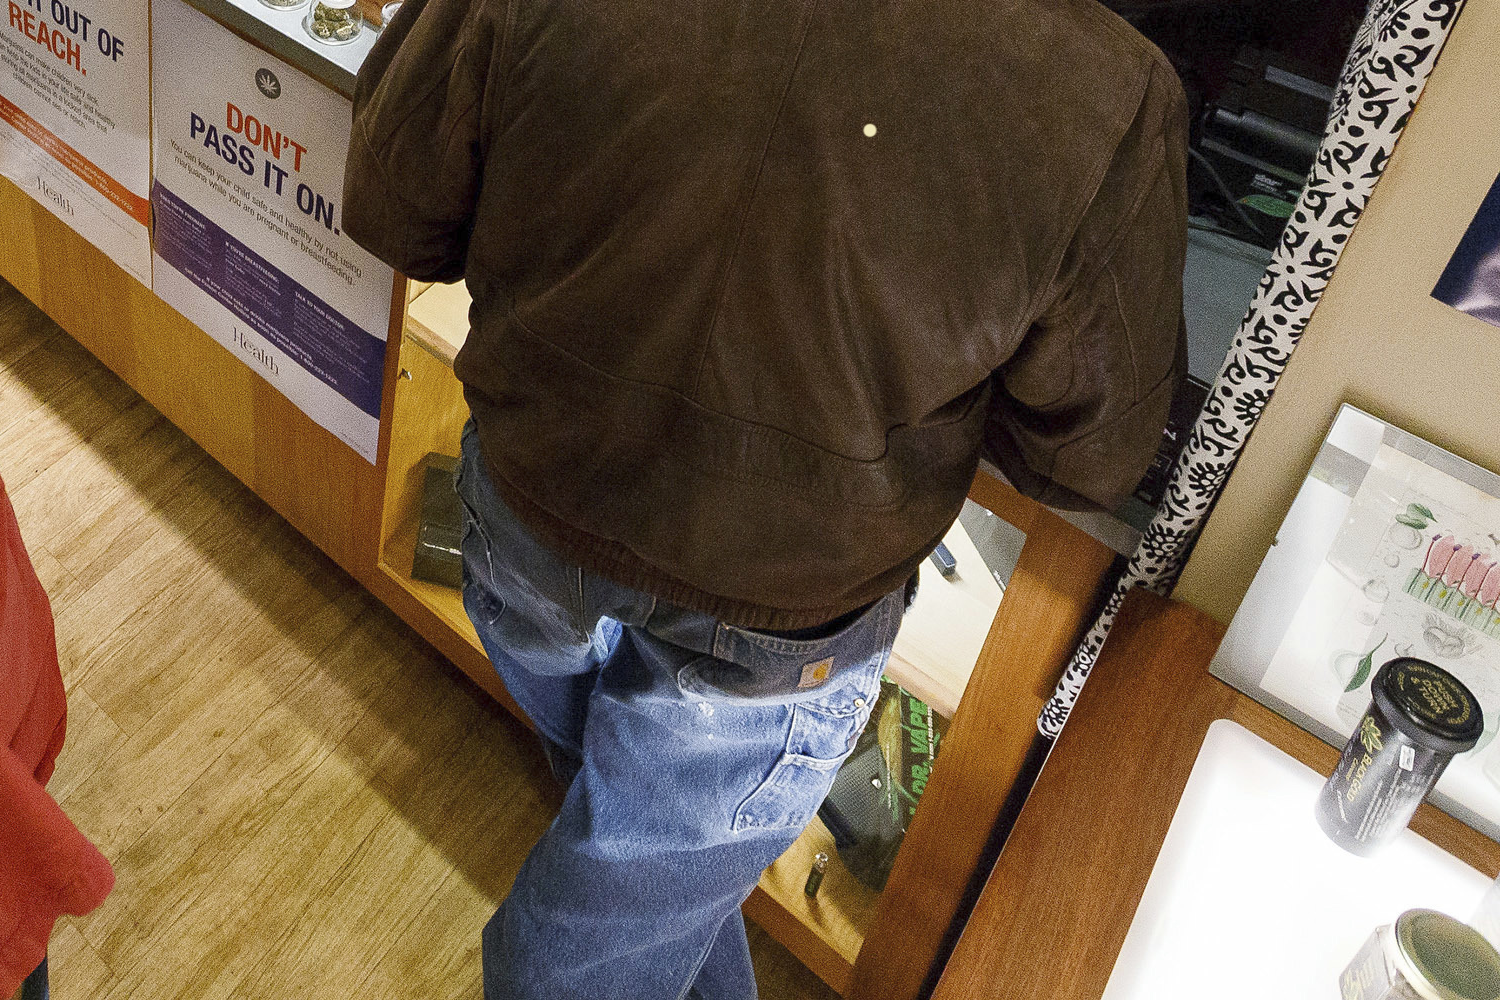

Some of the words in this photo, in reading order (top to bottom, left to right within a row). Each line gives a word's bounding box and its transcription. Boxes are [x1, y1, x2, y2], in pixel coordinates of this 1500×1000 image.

[8, 0, 87, 77] REACH.
[98, 28, 125, 62] OF
[226, 101, 307, 173] DON'T
[37, 175, 74, 216] Health
[190, 111, 255, 176] PASS
[264, 159, 288, 196] IT
[296, 183, 340, 236] ON.
[170, 138, 182, 153] You
[184, 149, 196, 163] can
[198, 157, 214, 178] keep
[216, 172, 232, 188] your
[233, 184, 250, 200] child
[252, 197, 267, 213] safe
[269, 209, 283, 223] and
[285, 218, 311, 247] healthy
[314, 238, 322, 255] by
[325, 248, 338, 262] not
[340, 258, 361, 282] using
[174, 155, 207, 183] marijuana
[208, 178, 226, 196] while
[228, 193, 241, 207] you
[243, 203, 254, 216] are
[256, 212, 288, 240] pregnant
[290, 236, 298, 247] or
[233, 326, 280, 377] Health
[1422, 679, 1450, 711] DOWN
[909, 697, 929, 754] VAPE
[1346, 779, 1364, 802] GOLD
[1358, 753, 1373, 783] BLACK
